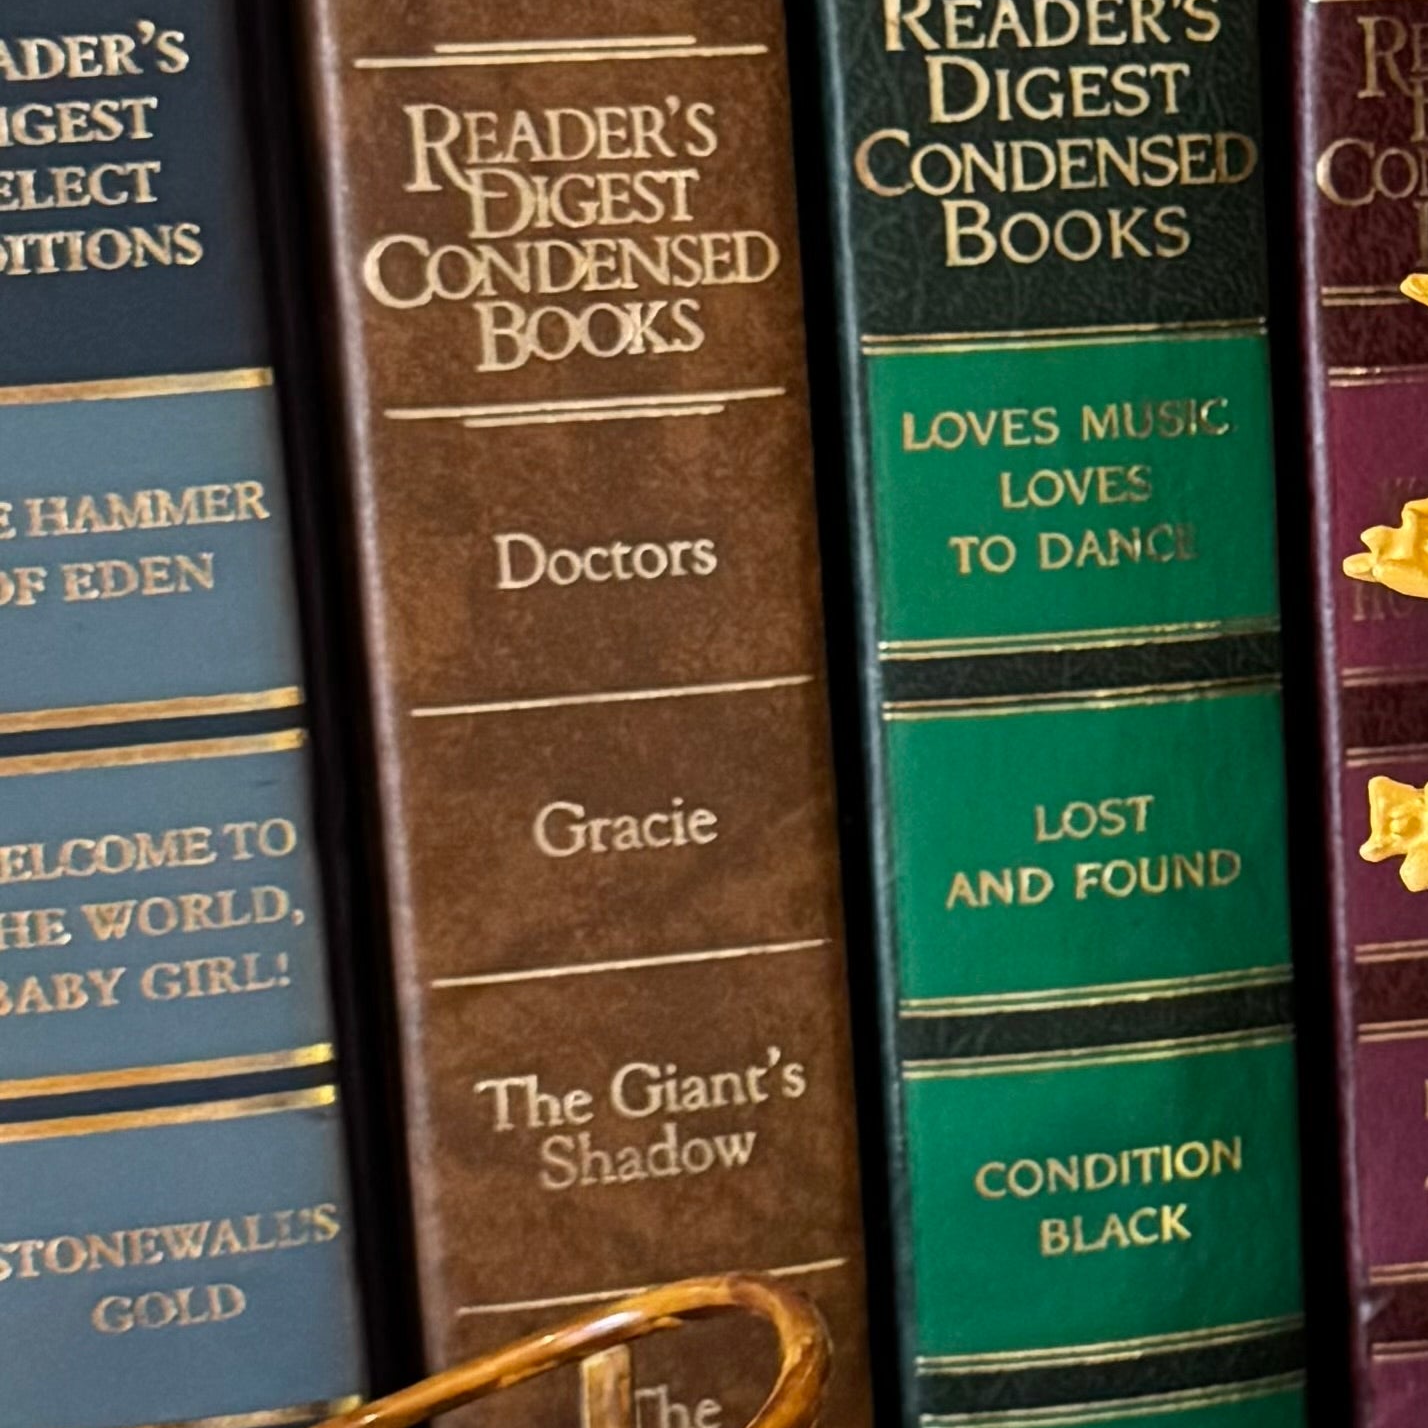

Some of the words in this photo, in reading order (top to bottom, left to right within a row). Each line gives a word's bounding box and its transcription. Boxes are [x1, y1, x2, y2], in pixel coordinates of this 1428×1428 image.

[924, 55, 1191, 123] DIGEST
[402, 95, 718, 192] READER'S
[854, 128, 1258, 198] CONDENSED
[464, 168, 699, 239] DIGEST
[0, 223, 203, 275] ITIONS
[942, 199, 1192, 267] BOOKS
[363, 230, 781, 309] CONDENSED
[475, 298, 705, 372] BOOKS
[902, 406, 1060, 452] LOVES
[1081, 397, 1230, 442] MUSIC
[24, 481, 270, 537] HAMMER
[1000, 464, 1152, 510] LOVES
[61, 552, 214, 602] EDEN
[494, 532, 718, 590] Doctors
[949, 535, 1017, 576] TO
[222, 818, 297, 860] TO
[532, 797, 718, 858] Gracie
[1034, 795, 1154, 843] LOST
[945, 866, 1054, 910] AND
[1074, 848, 1243, 900] FOUND
[80, 885, 305, 940] WORLD,
[140, 952, 290, 1000] GIRL!
[473, 1074, 594, 1133] The
[610, 1045, 807, 1118] Giant's
[540, 1122, 757, 1191] Shadow
[974, 1135, 1243, 1200] CONDITION
[1039, 1202, 1192, 1258] BLACK
[91, 1283, 247, 1334] GOLD
